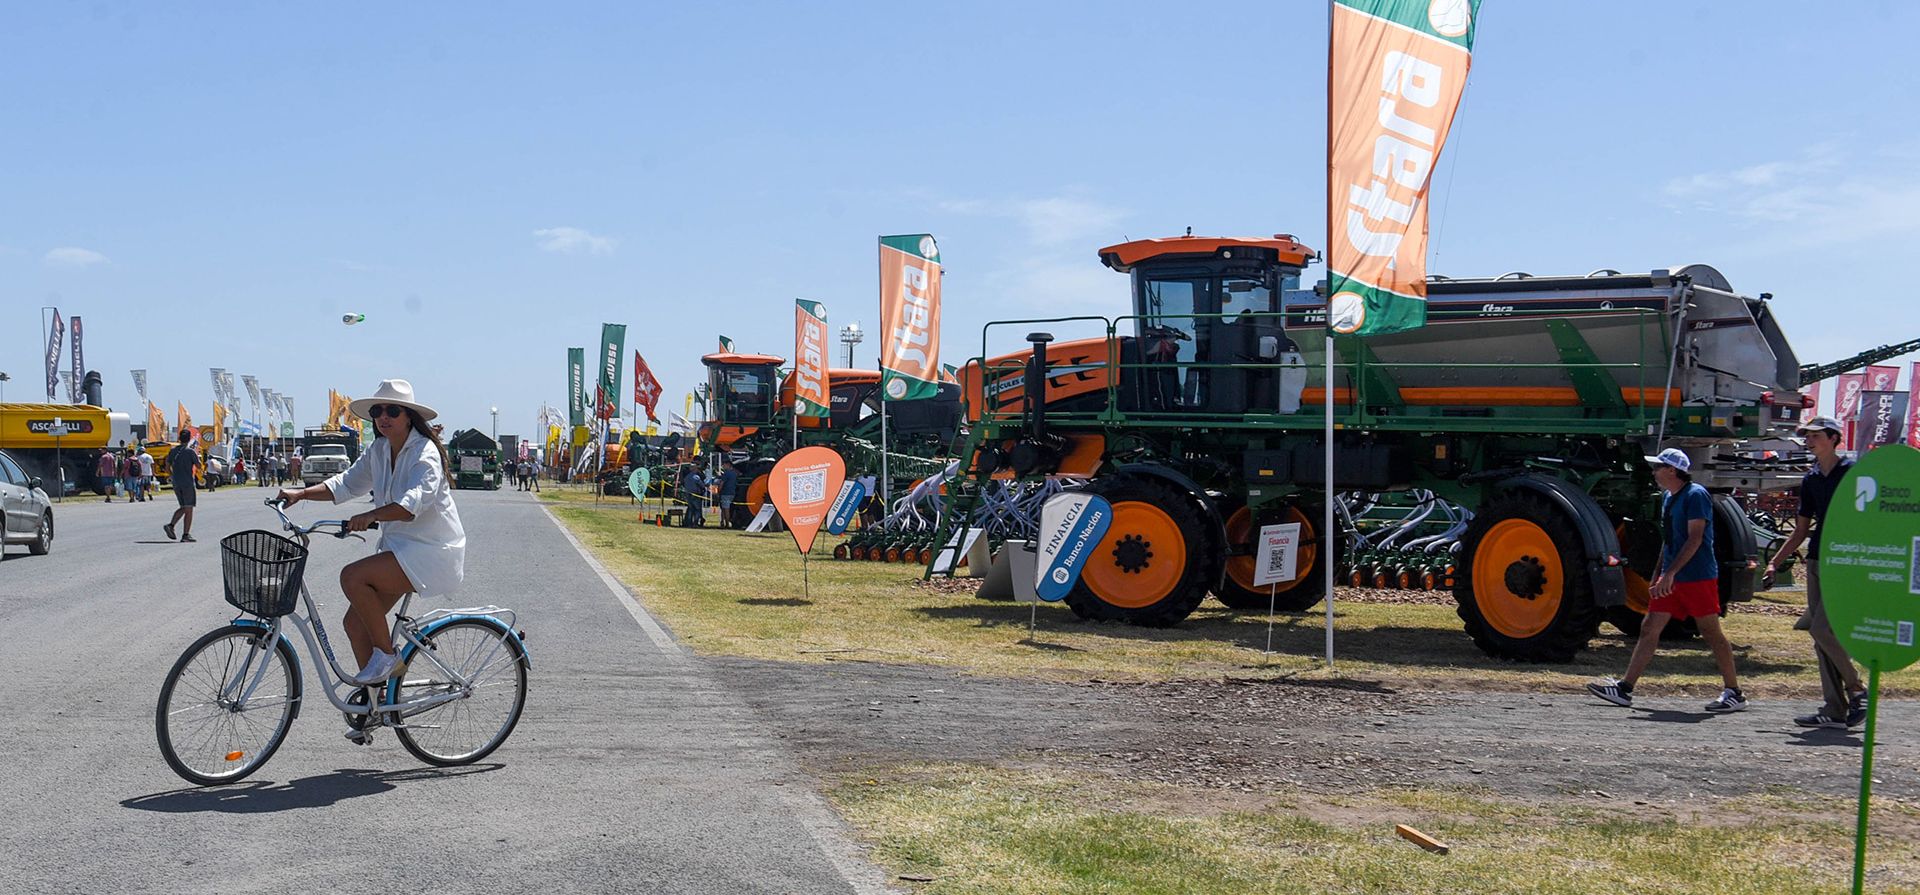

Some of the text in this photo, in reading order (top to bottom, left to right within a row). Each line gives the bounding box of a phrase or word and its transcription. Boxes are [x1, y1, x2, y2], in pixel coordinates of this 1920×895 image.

[1347, 50, 1442, 270] Stara
[893, 264, 929, 370] Stara
[1479, 303, 1514, 317] Stara
[1694, 321, 1714, 329] Stara
[798, 320, 822, 399] Stara
[830, 395, 848, 403] Stara
[1874, 394, 1888, 442] ORLANDI
[832, 484, 851, 512] FINANCIA
[1880, 485, 1912, 498] Banco
[1045, 502, 1083, 556] FINANCIA
[1063, 511, 1103, 567] Banco Nación
